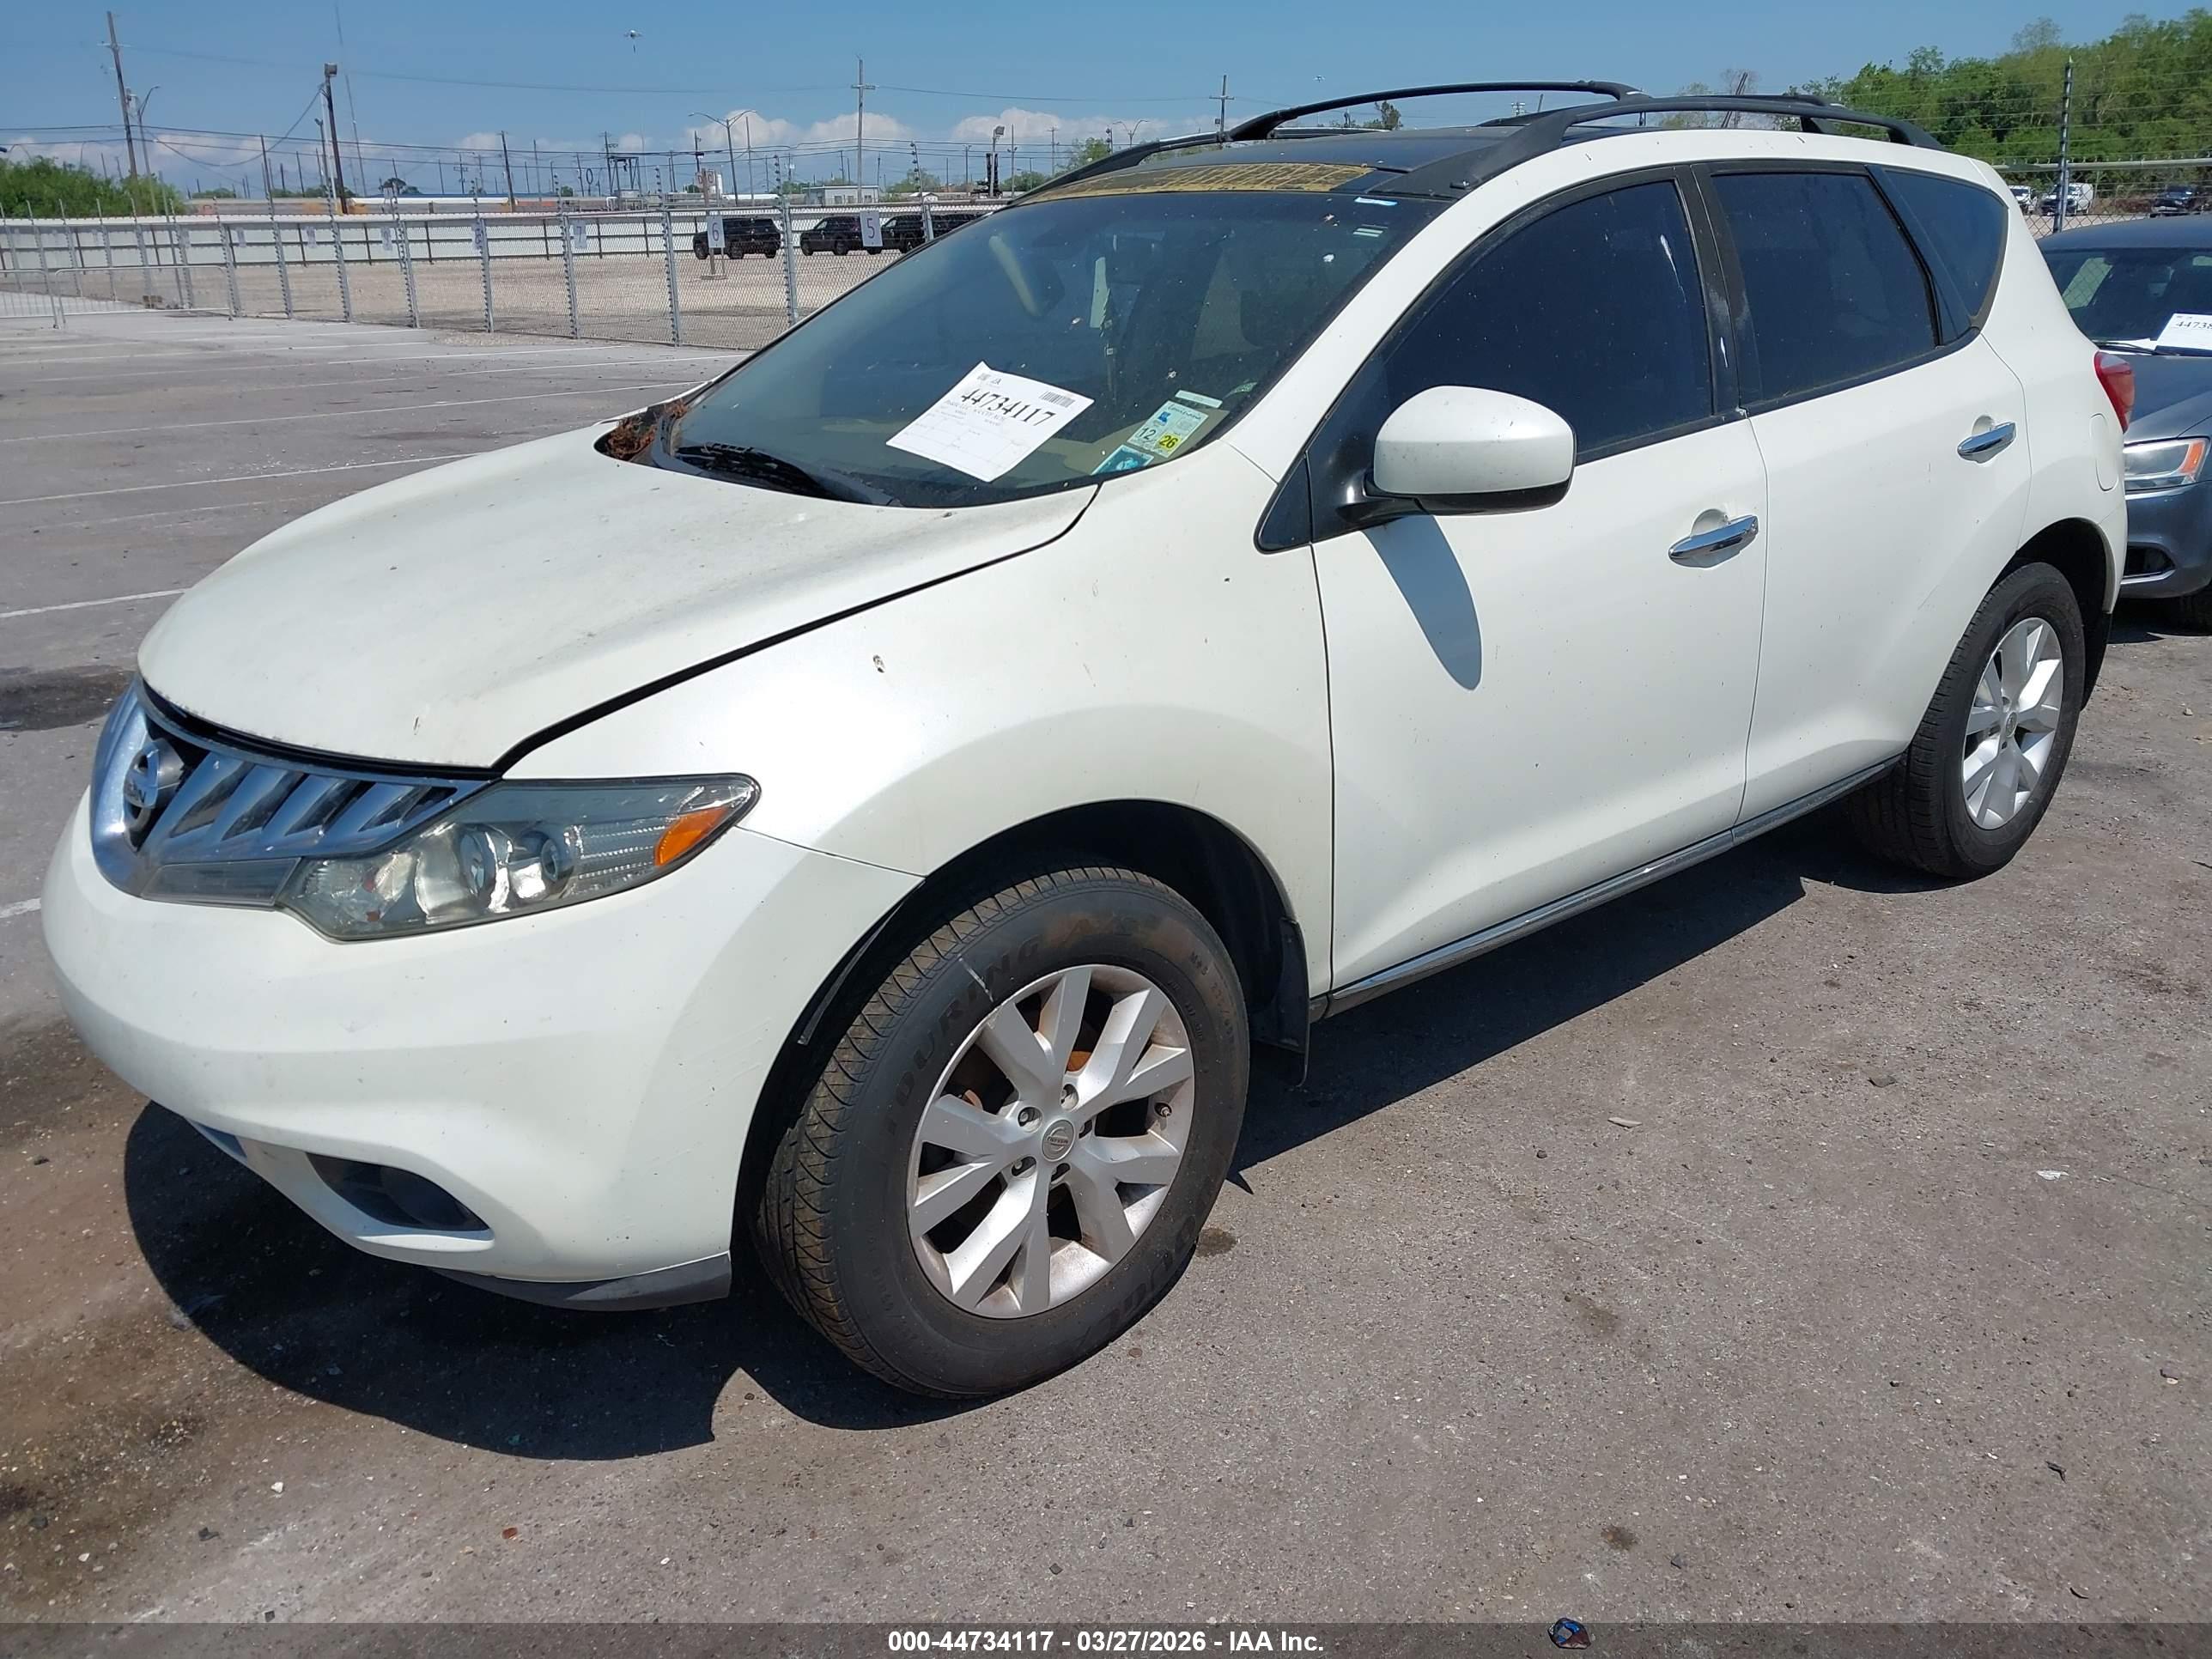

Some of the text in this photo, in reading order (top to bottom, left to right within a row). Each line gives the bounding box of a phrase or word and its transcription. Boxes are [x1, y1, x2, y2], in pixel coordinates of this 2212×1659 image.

[575, 226, 583, 243] 7
[711, 222, 720, 242] 6
[866, 216, 876, 240] 5
[961, 387, 1057, 427] 44734117
[1138, 428, 1157, 441] 12
[1158, 435, 1179, 449] 26
